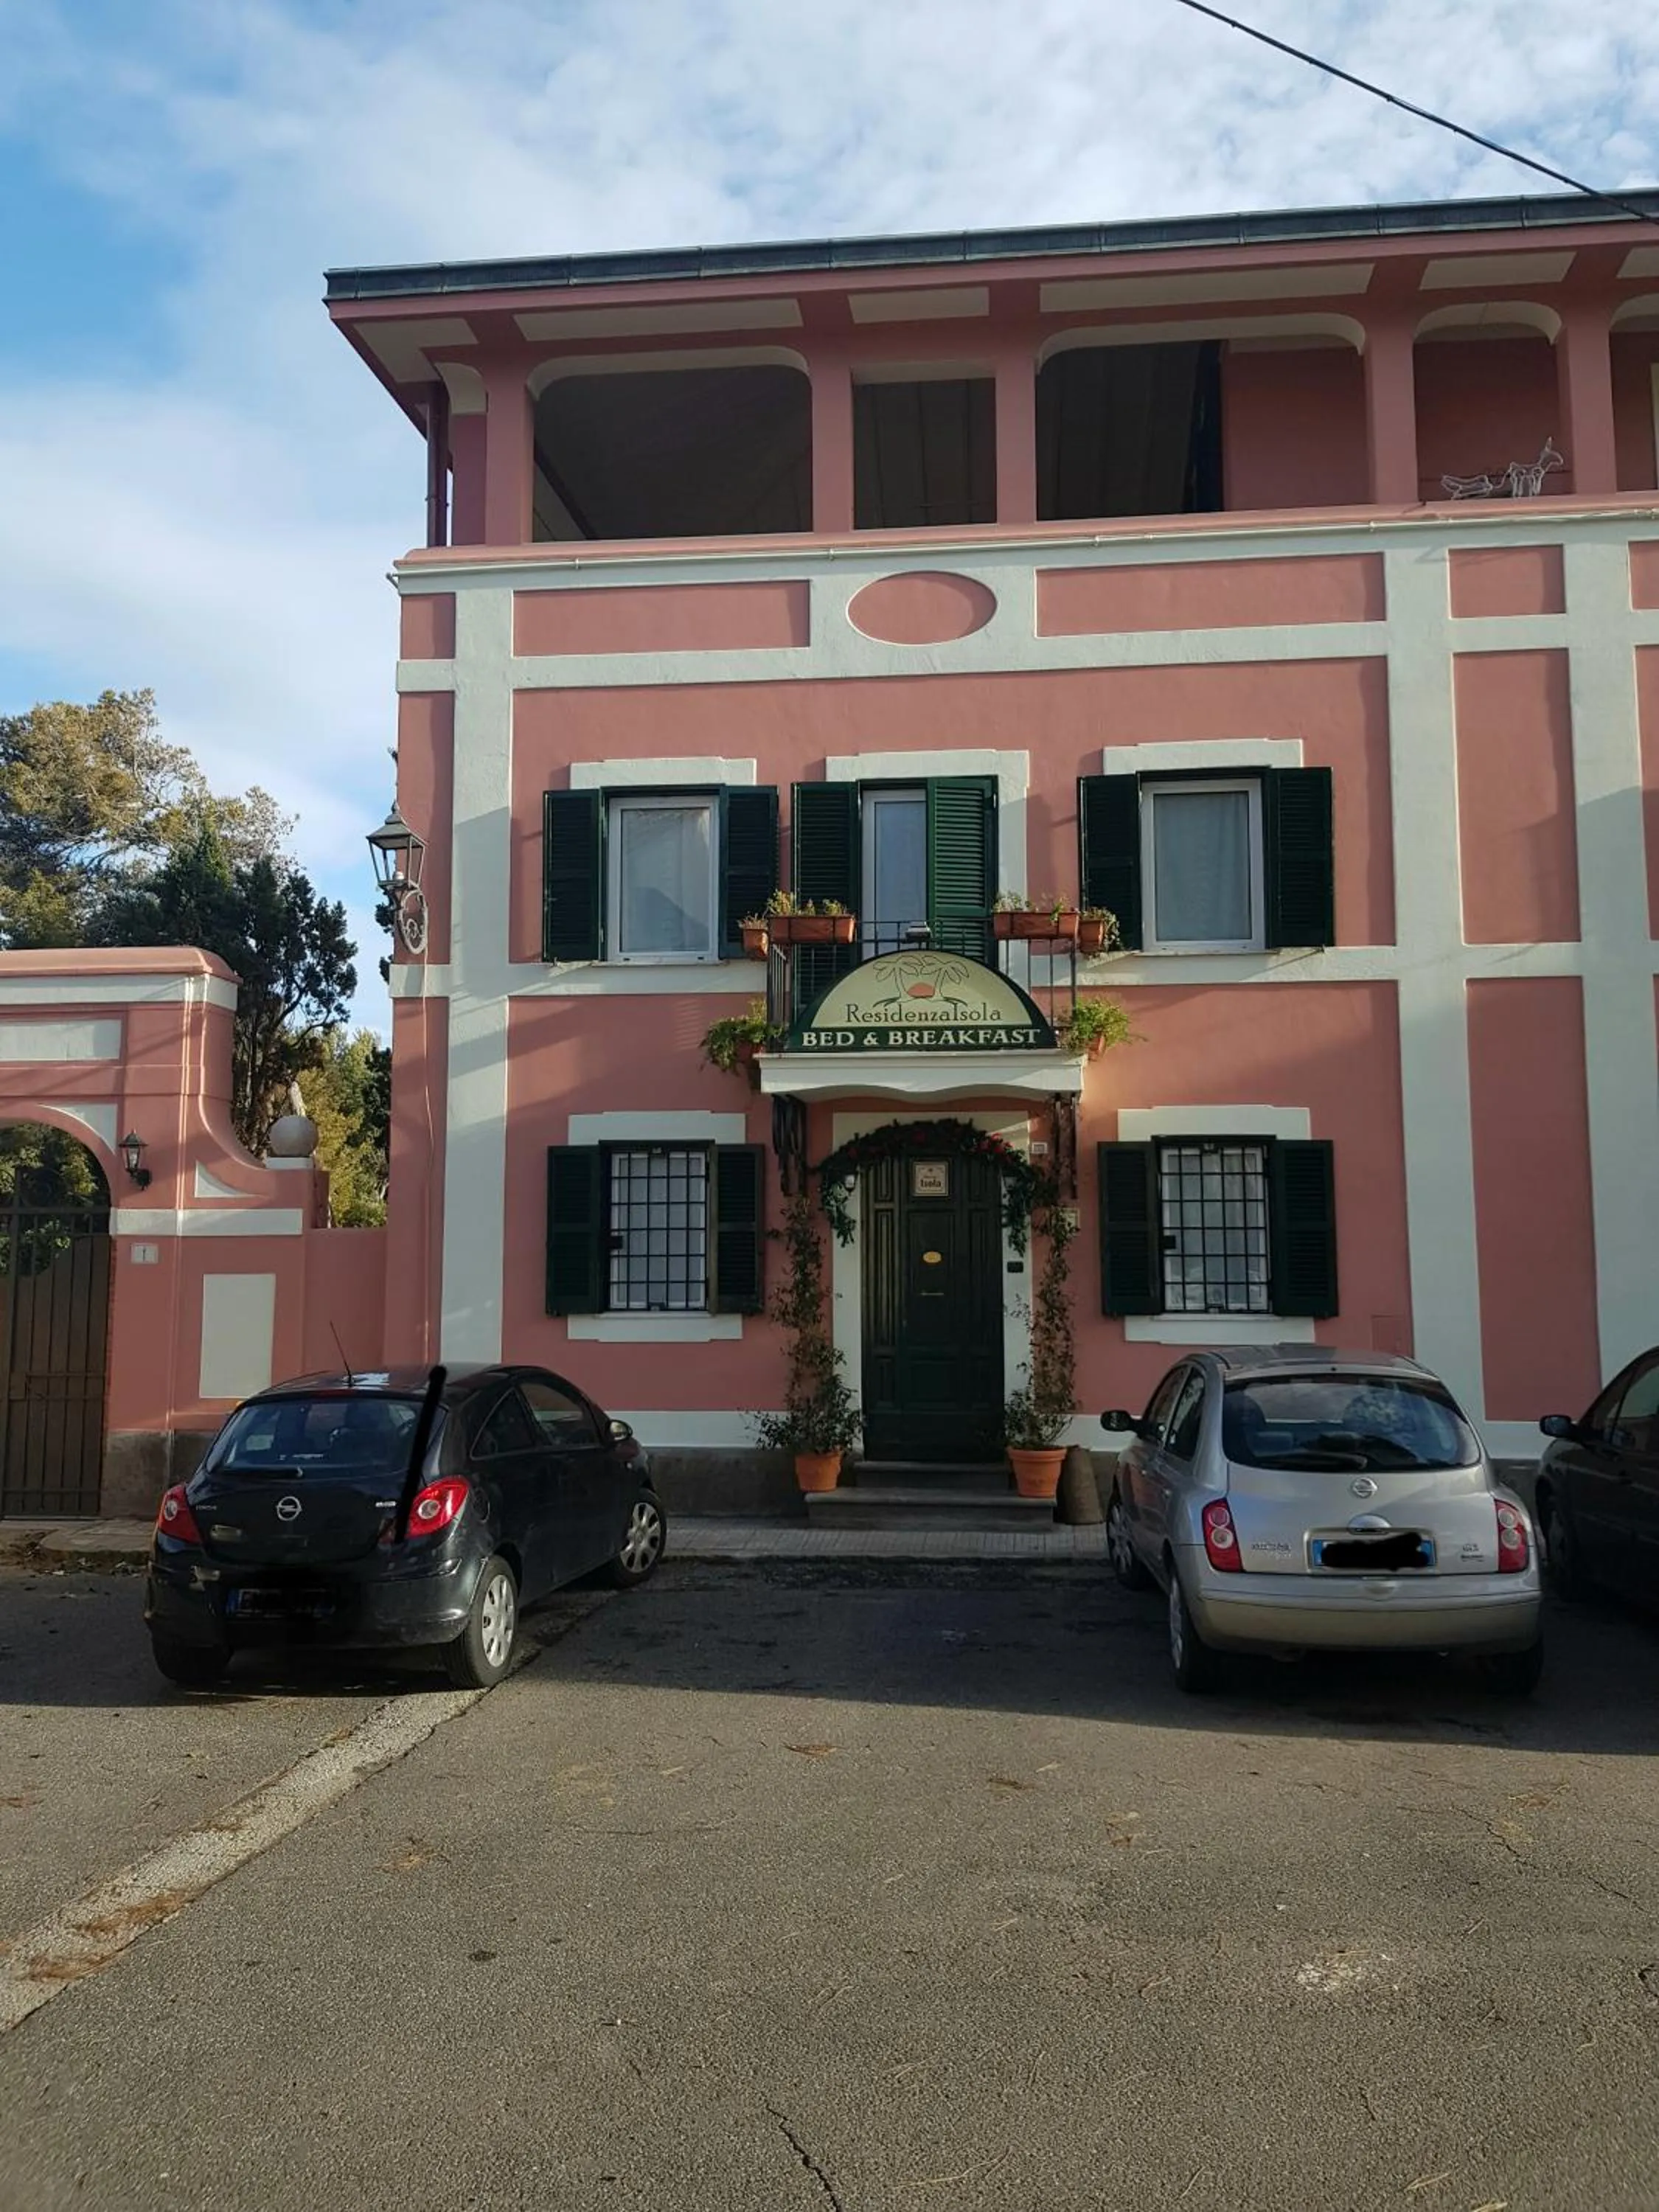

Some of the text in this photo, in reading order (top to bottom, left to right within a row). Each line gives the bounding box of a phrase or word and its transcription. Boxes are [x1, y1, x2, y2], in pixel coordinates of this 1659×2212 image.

[802, 1029, 1041, 1047] BED & BREAKFAST
